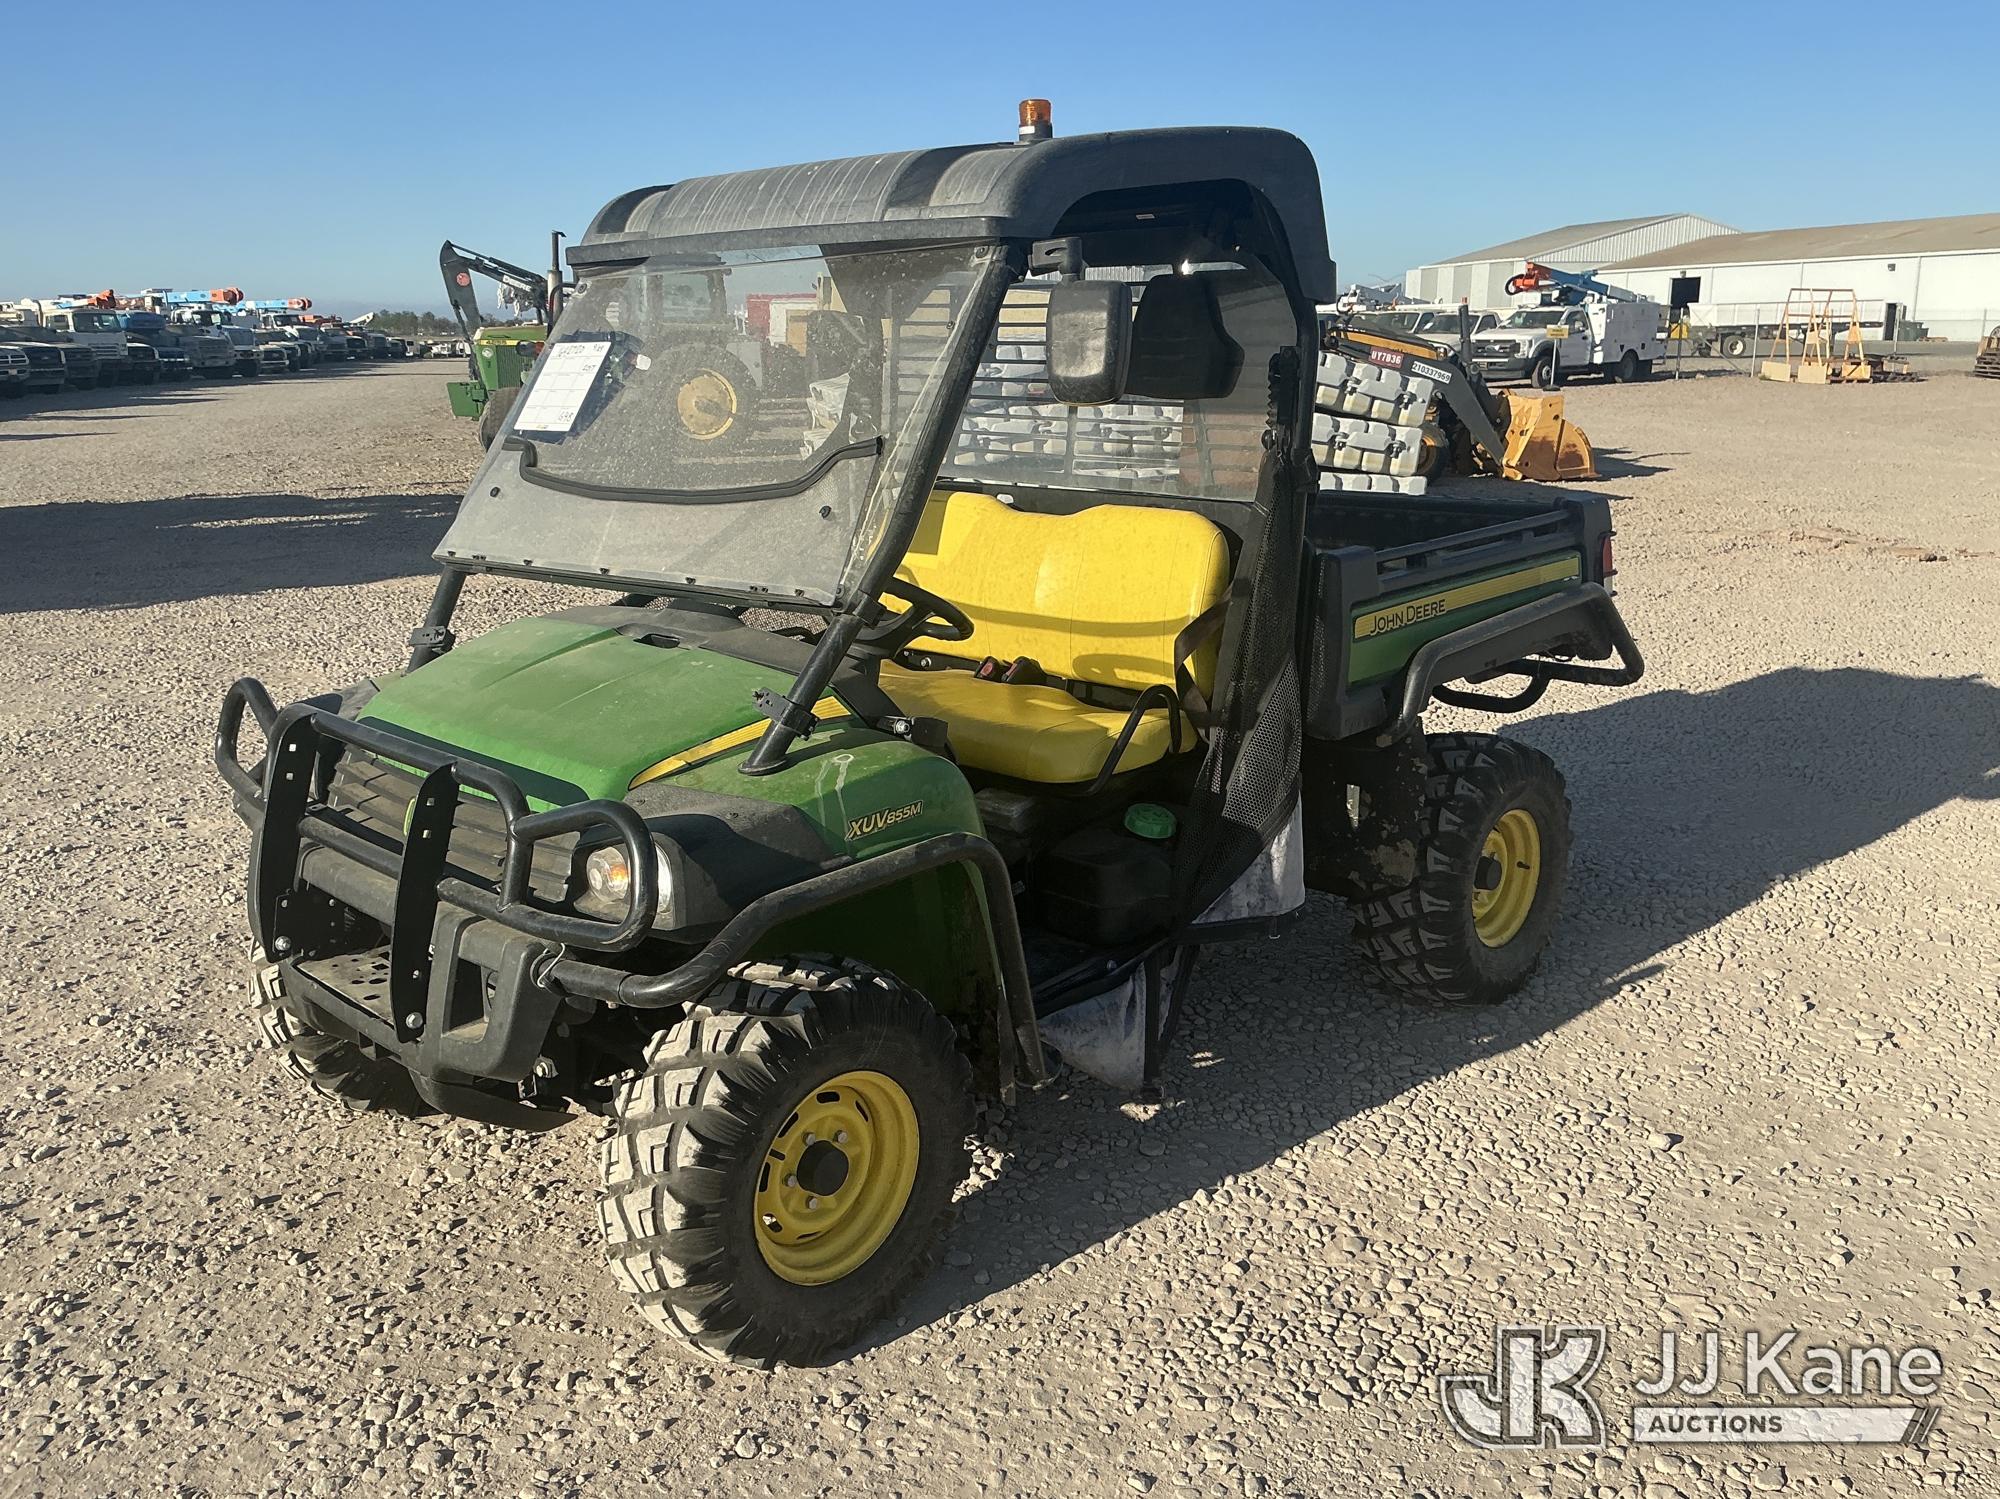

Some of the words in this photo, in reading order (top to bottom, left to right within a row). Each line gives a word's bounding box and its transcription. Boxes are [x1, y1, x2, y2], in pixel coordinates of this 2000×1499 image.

[1369, 610, 1404, 634] JOHN
[1406, 598, 1446, 622] DEERE
[847, 801, 922, 840] XUV855M
